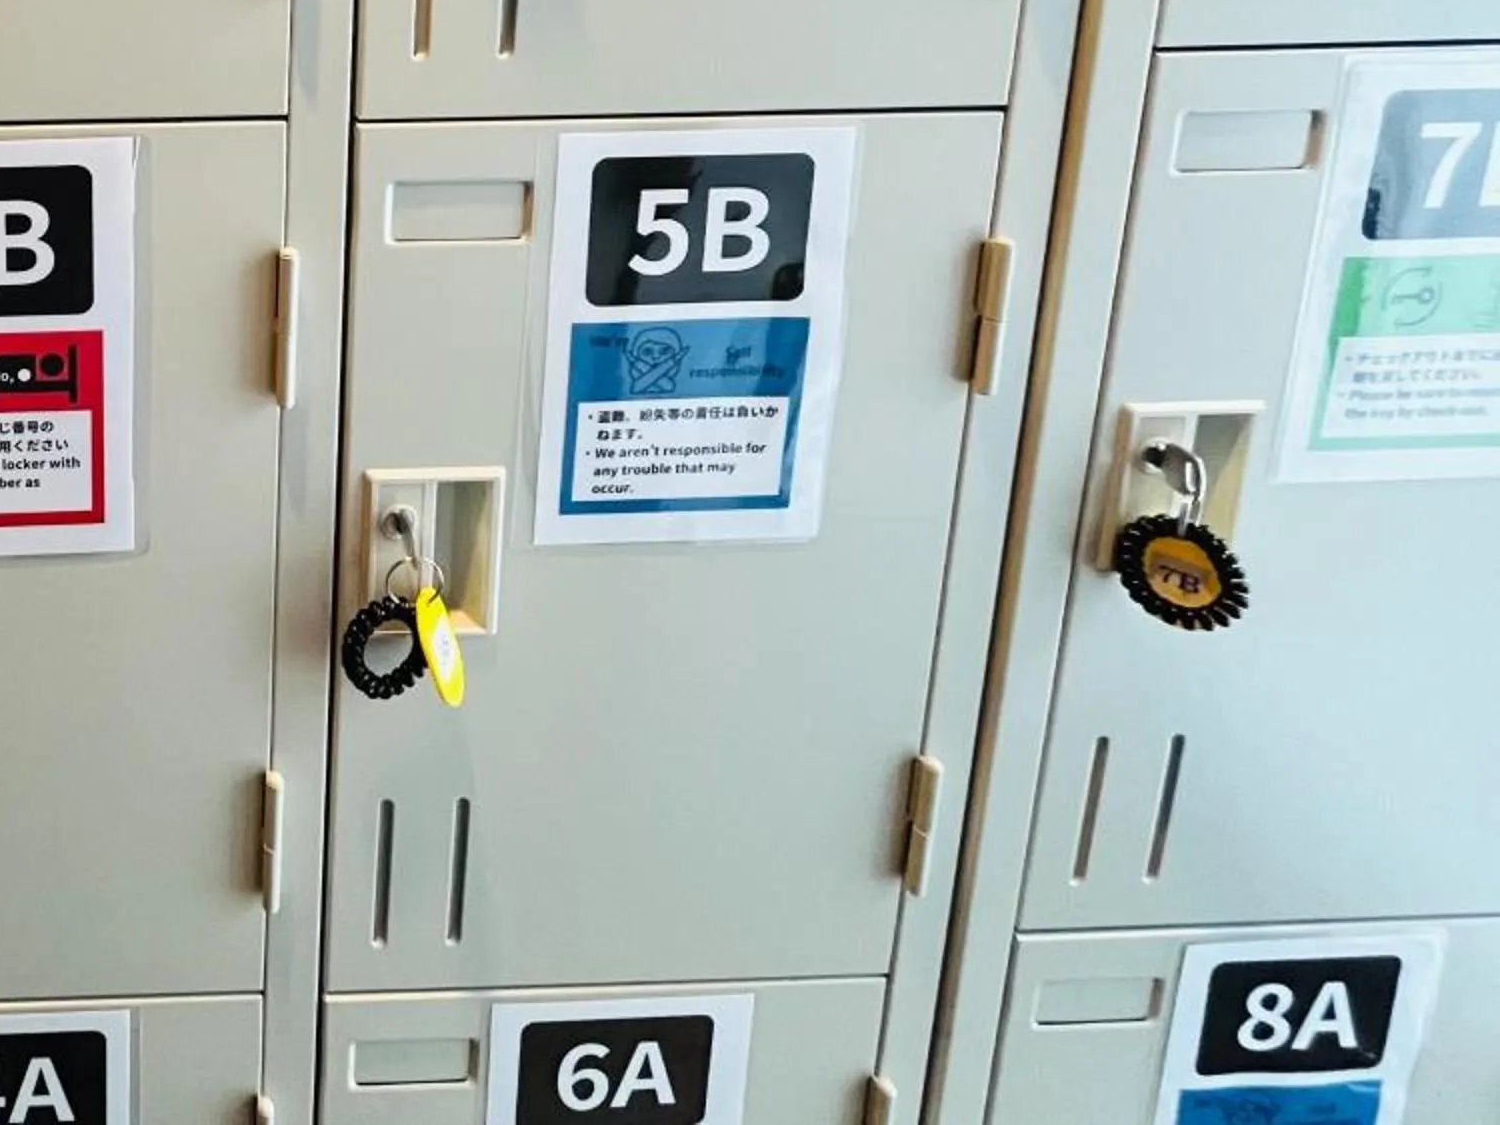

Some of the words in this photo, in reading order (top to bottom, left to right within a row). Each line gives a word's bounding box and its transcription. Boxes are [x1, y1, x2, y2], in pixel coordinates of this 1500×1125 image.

[628, 187, 770, 276] 5B
[595, 447, 615, 458] We
[619, 445, 659, 458] aren't
[663, 442, 743, 458] responsible
[746, 442, 766, 453] for
[2, 459, 45, 471] locker
[50, 457, 81, 469] with
[594, 467, 619, 478] any
[622, 463, 672, 475] trouble
[676, 461, 703, 474] that
[707, 463, 735, 474] may
[26, 479, 40, 488] as
[592, 484, 634, 494] occur.
[1158, 565, 1199, 593] 7B
[1237, 981, 1358, 1052] 8A
[557, 1041, 676, 1112] 6A
